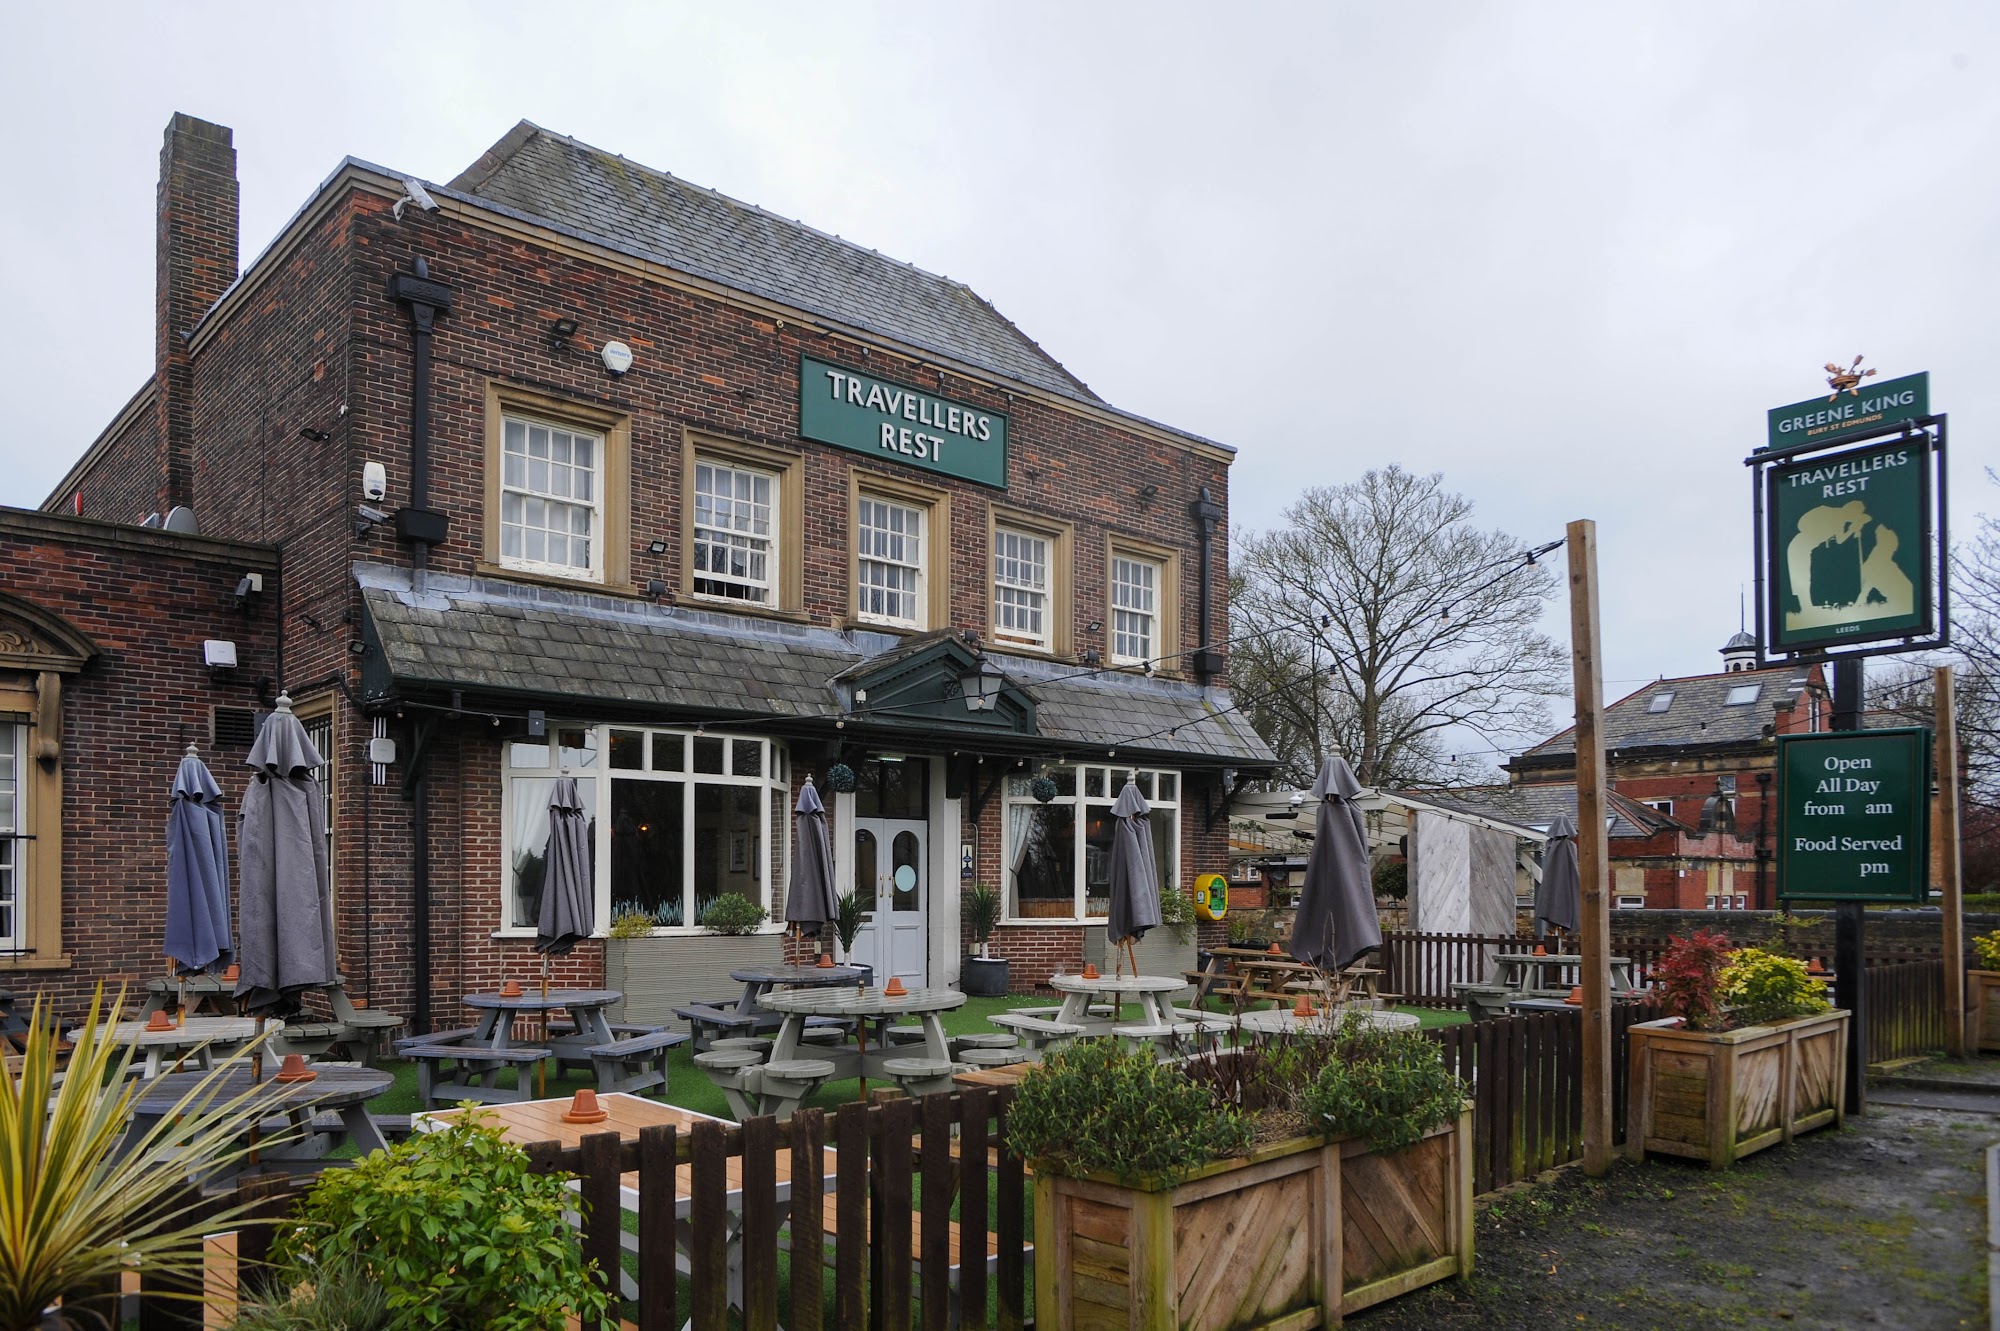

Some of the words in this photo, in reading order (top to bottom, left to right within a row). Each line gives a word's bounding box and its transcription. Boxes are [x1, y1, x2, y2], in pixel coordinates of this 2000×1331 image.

[827, 371, 990, 441] TRAVELLERS
[1778, 404, 1854, 433] GREENE
[1861, 390, 1915, 414] KING
[1807, 426, 1828, 436] BURY
[1830, 423, 1840, 431] ST
[1841, 413, 1883, 428] EDMUNDS
[881, 423, 945, 462] REST
[1788, 451, 1908, 488] TRAVELLERS
[1822, 476, 1870, 498] REST
[1836, 624, 1861, 634] LEEDS
[1824, 756, 1872, 774] Open
[1815, 778, 1841, 793] All
[1846, 778, 1881, 795] Day
[1804, 801, 1845, 816] from
[1864, 802, 1893, 815] am
[1794, 837, 1837, 852] Food
[1840, 834, 1903, 851] Served
[1860, 862, 1890, 878] pm
